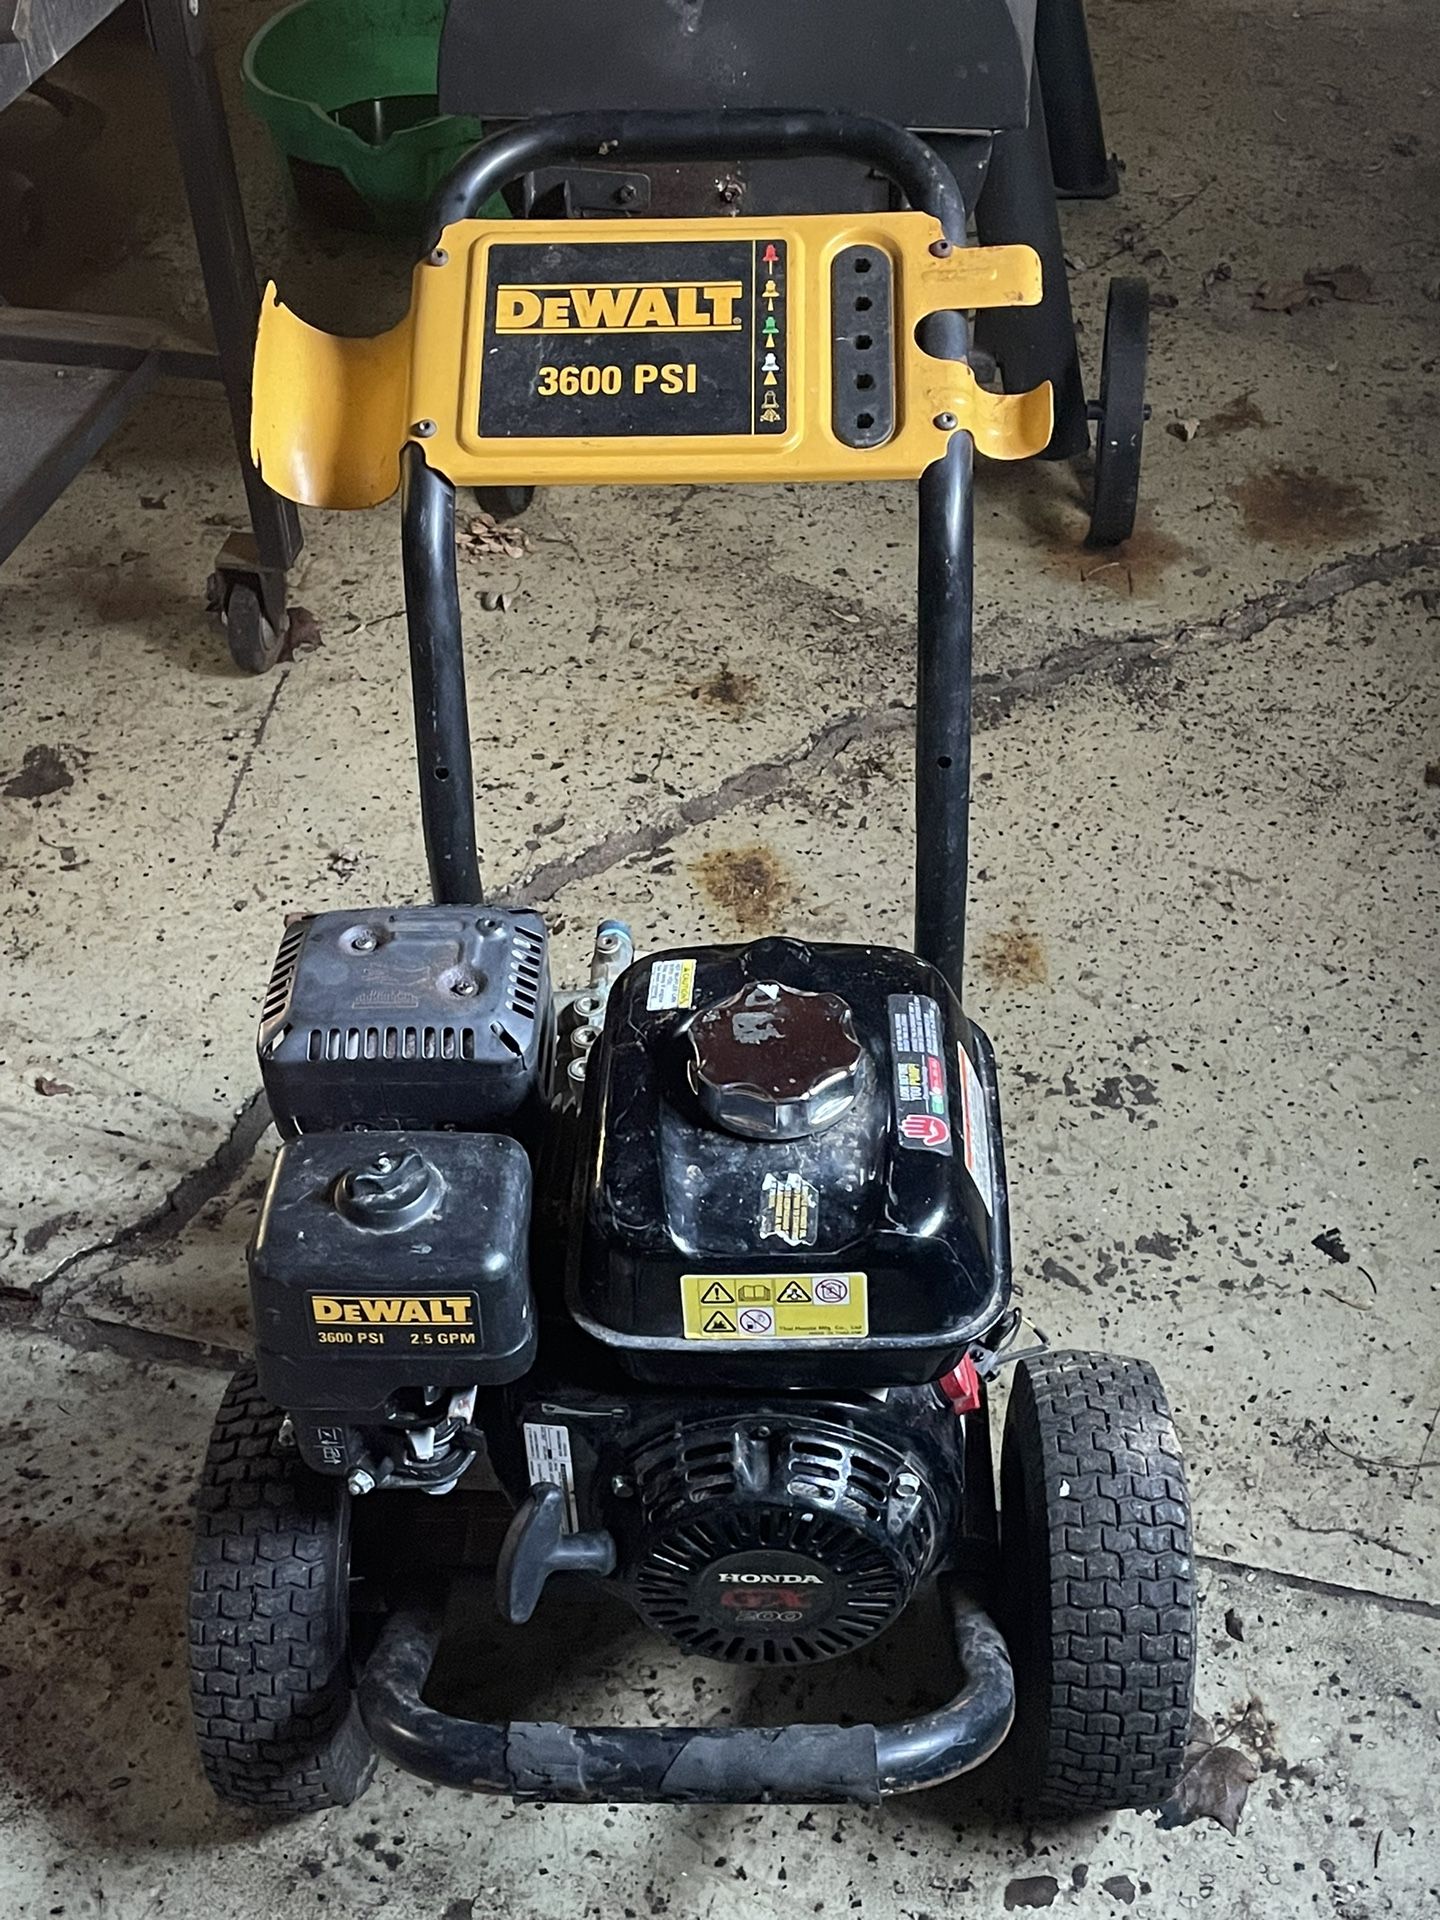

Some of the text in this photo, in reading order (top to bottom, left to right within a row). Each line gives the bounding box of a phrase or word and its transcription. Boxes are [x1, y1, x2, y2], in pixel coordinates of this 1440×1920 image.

[538, 364, 697, 396] 3600 PSI
[910, 1086, 922, 1101] YOU
[318, 1332, 476, 1345] 3600 PSI 2.5 GPM
[718, 1573, 824, 1584] HONDA
[735, 1610, 804, 1622] 200
